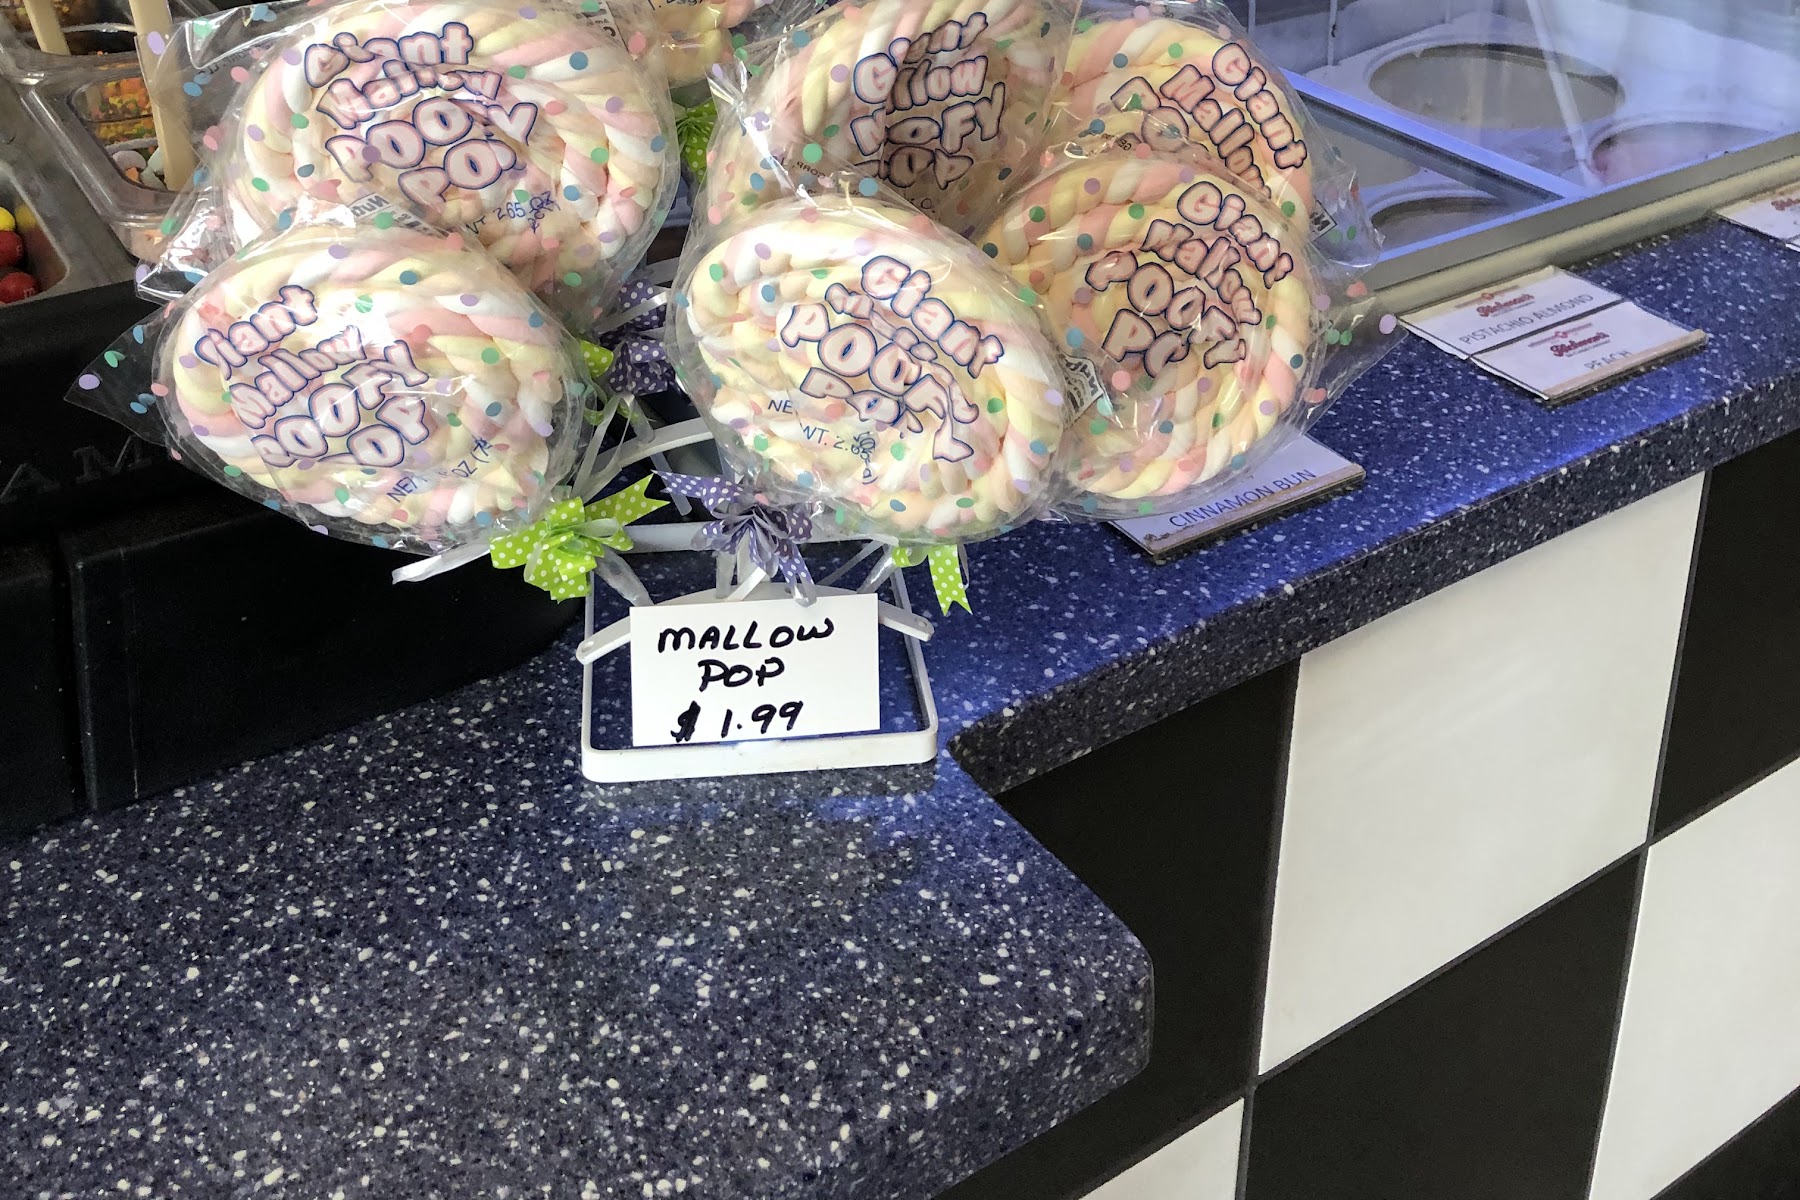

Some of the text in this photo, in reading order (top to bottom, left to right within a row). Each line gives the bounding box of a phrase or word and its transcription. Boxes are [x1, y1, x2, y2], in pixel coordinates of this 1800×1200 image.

[1212, 42, 1307, 169] Giant
[861, 255, 1004, 378] Giant
[1460, 313, 1534, 346] PISTACHIO
[1533, 293, 1595, 322] ALMOND
[229, 324, 367, 430] Mallow
[1169, 468, 1317, 527] CINNAMON BUN
[657, 617, 835, 653] MALLOW
[697, 657, 785, 692] POP
